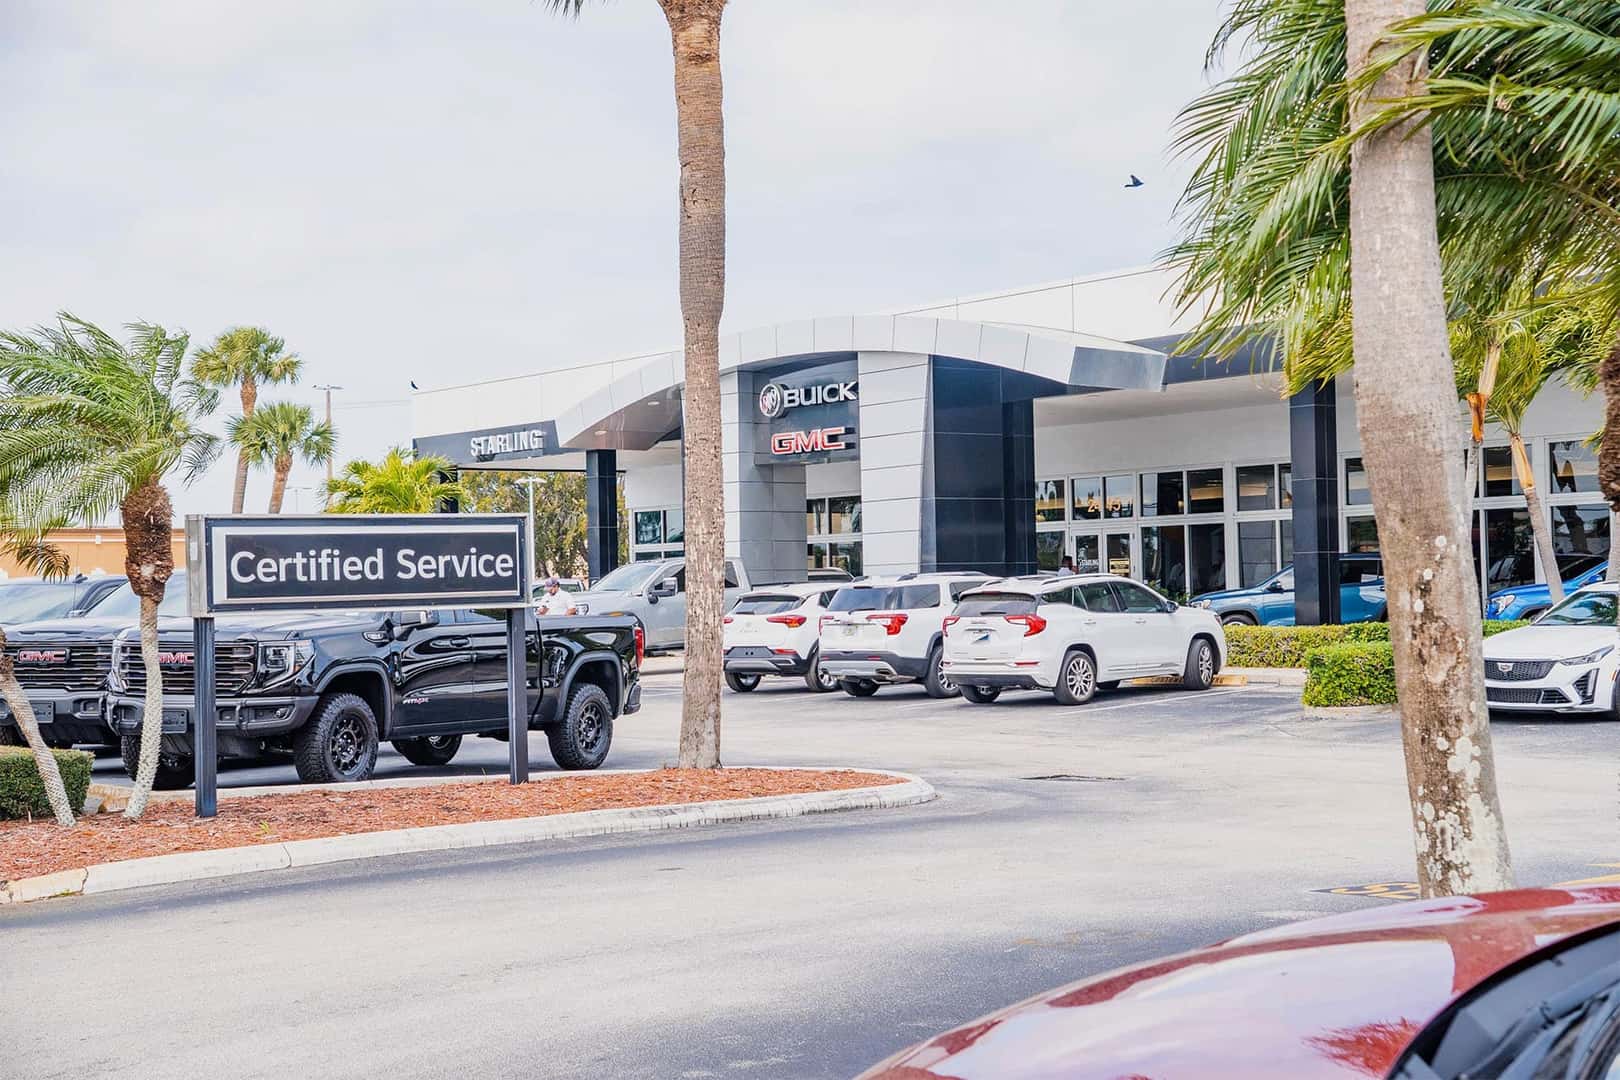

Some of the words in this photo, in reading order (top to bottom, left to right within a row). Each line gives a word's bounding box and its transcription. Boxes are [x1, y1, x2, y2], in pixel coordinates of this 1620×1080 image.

[783, 381, 857, 408] BUICK
[470, 430, 545, 457] STARLING
[771, 426, 845, 455] GMC
[230, 548, 384, 583] Certified
[396, 547, 513, 579] Service
[19, 650, 66, 663] GMC
